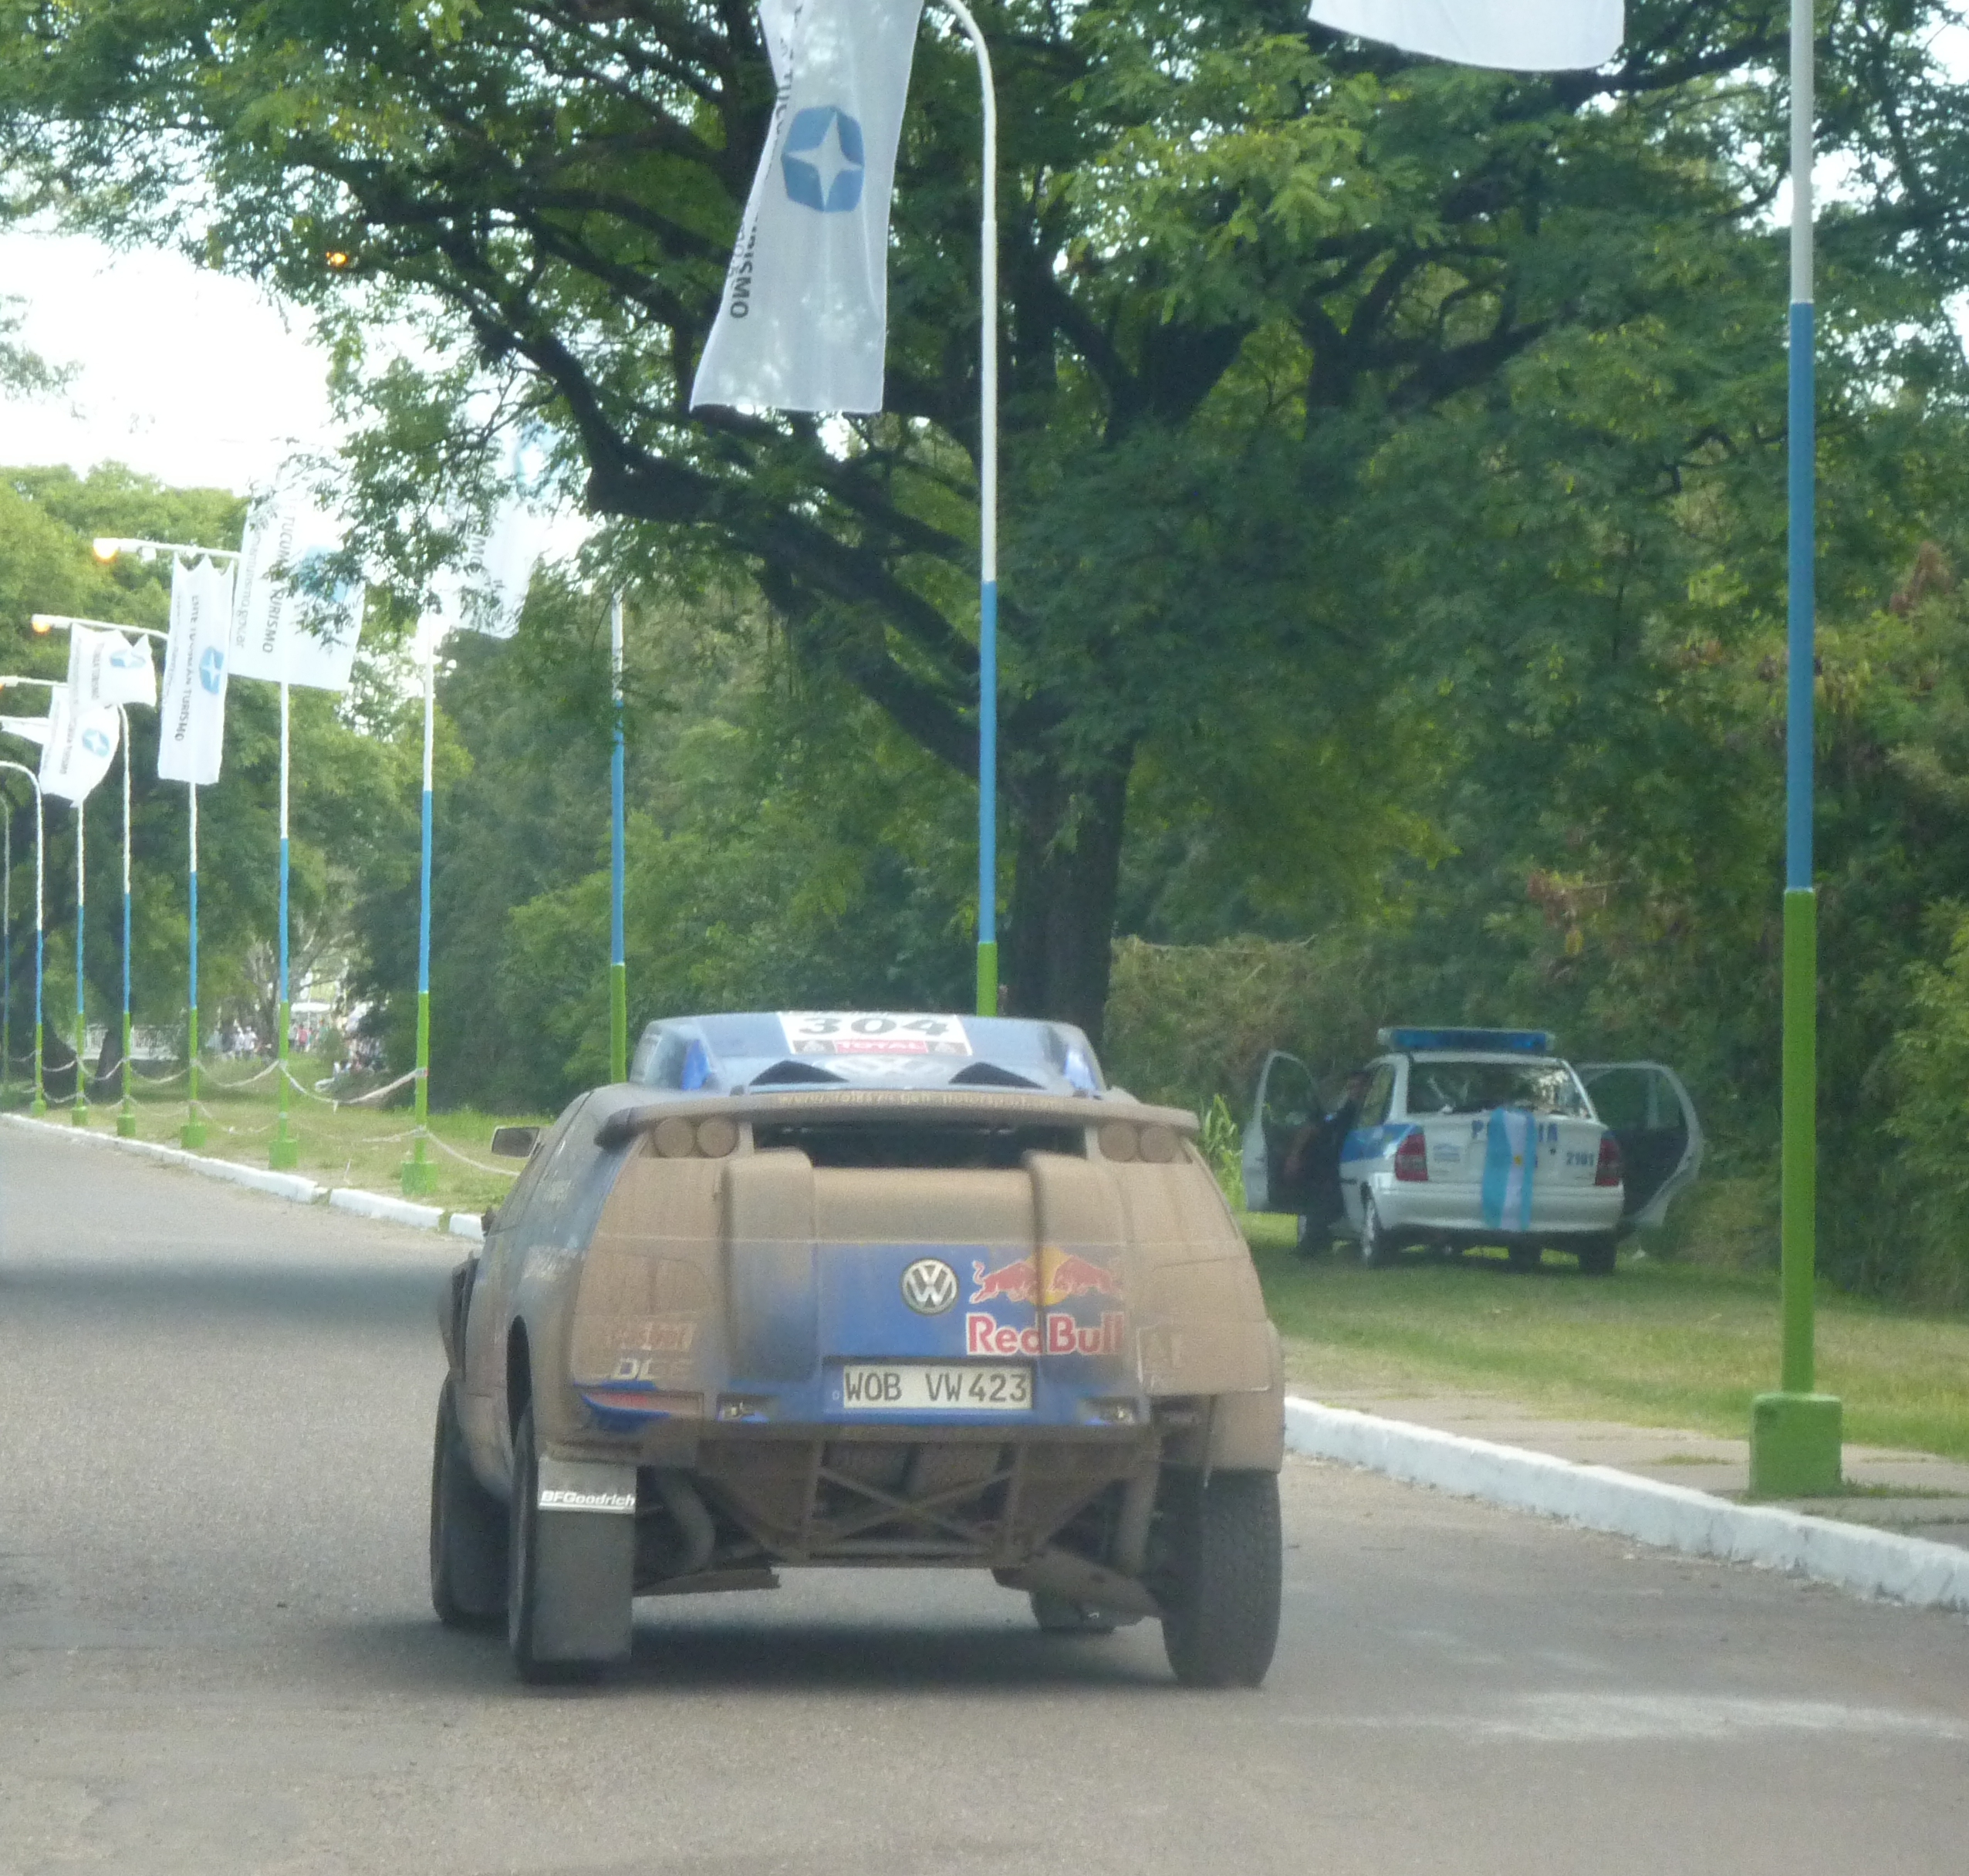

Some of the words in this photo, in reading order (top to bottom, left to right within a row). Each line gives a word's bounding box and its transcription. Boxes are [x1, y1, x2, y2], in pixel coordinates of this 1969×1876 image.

[798, 1017, 949, 1036] 304
[967, 1313, 1040, 1354] Red
[1046, 1313, 1123, 1354] Bull
[846, 1372, 902, 1402] WOB
[926, 1372, 963, 1402] VW
[968, 1372, 1027, 1403] 423
[541, 1490, 636, 1506] BFGoodrich
